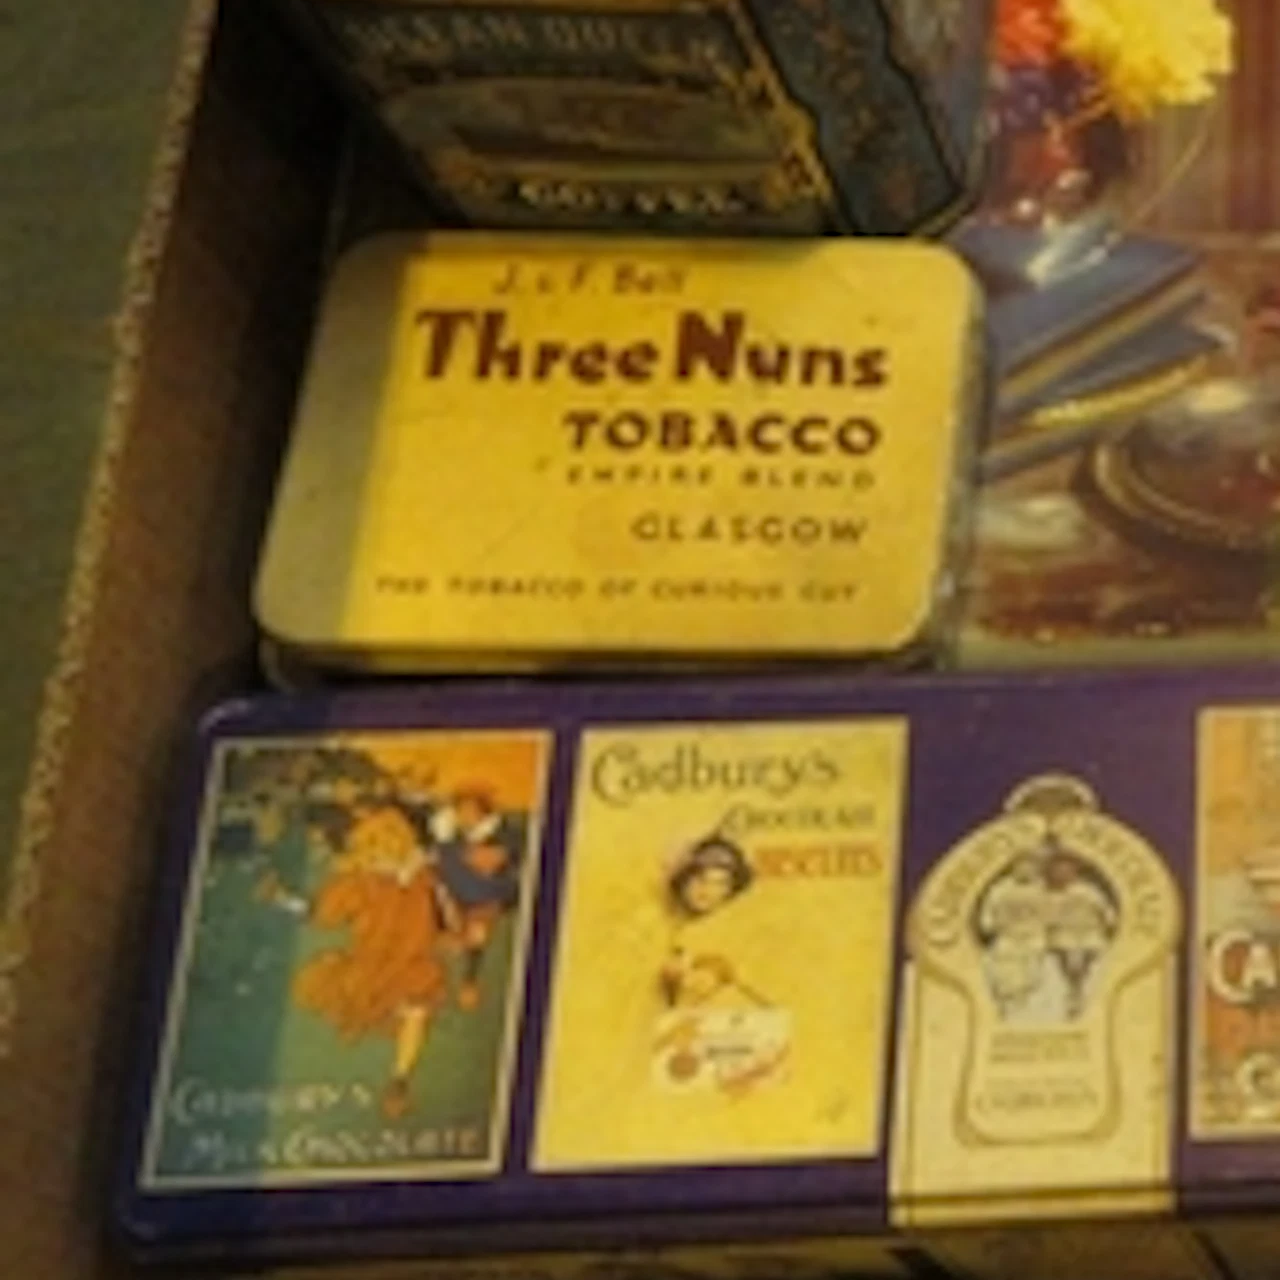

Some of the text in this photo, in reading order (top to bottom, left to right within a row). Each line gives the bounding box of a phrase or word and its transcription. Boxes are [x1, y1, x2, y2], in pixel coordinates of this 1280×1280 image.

[415, 308, 889, 388] Three Nuns
[562, 408, 882, 456] TOBACCO
[567, 466, 876, 491] EMPIRE BLEND
[629, 511, 869, 545] GLASGOW
[446, 576, 585, 600] TOBACCO
[591, 741, 841, 809] Cadbury's
